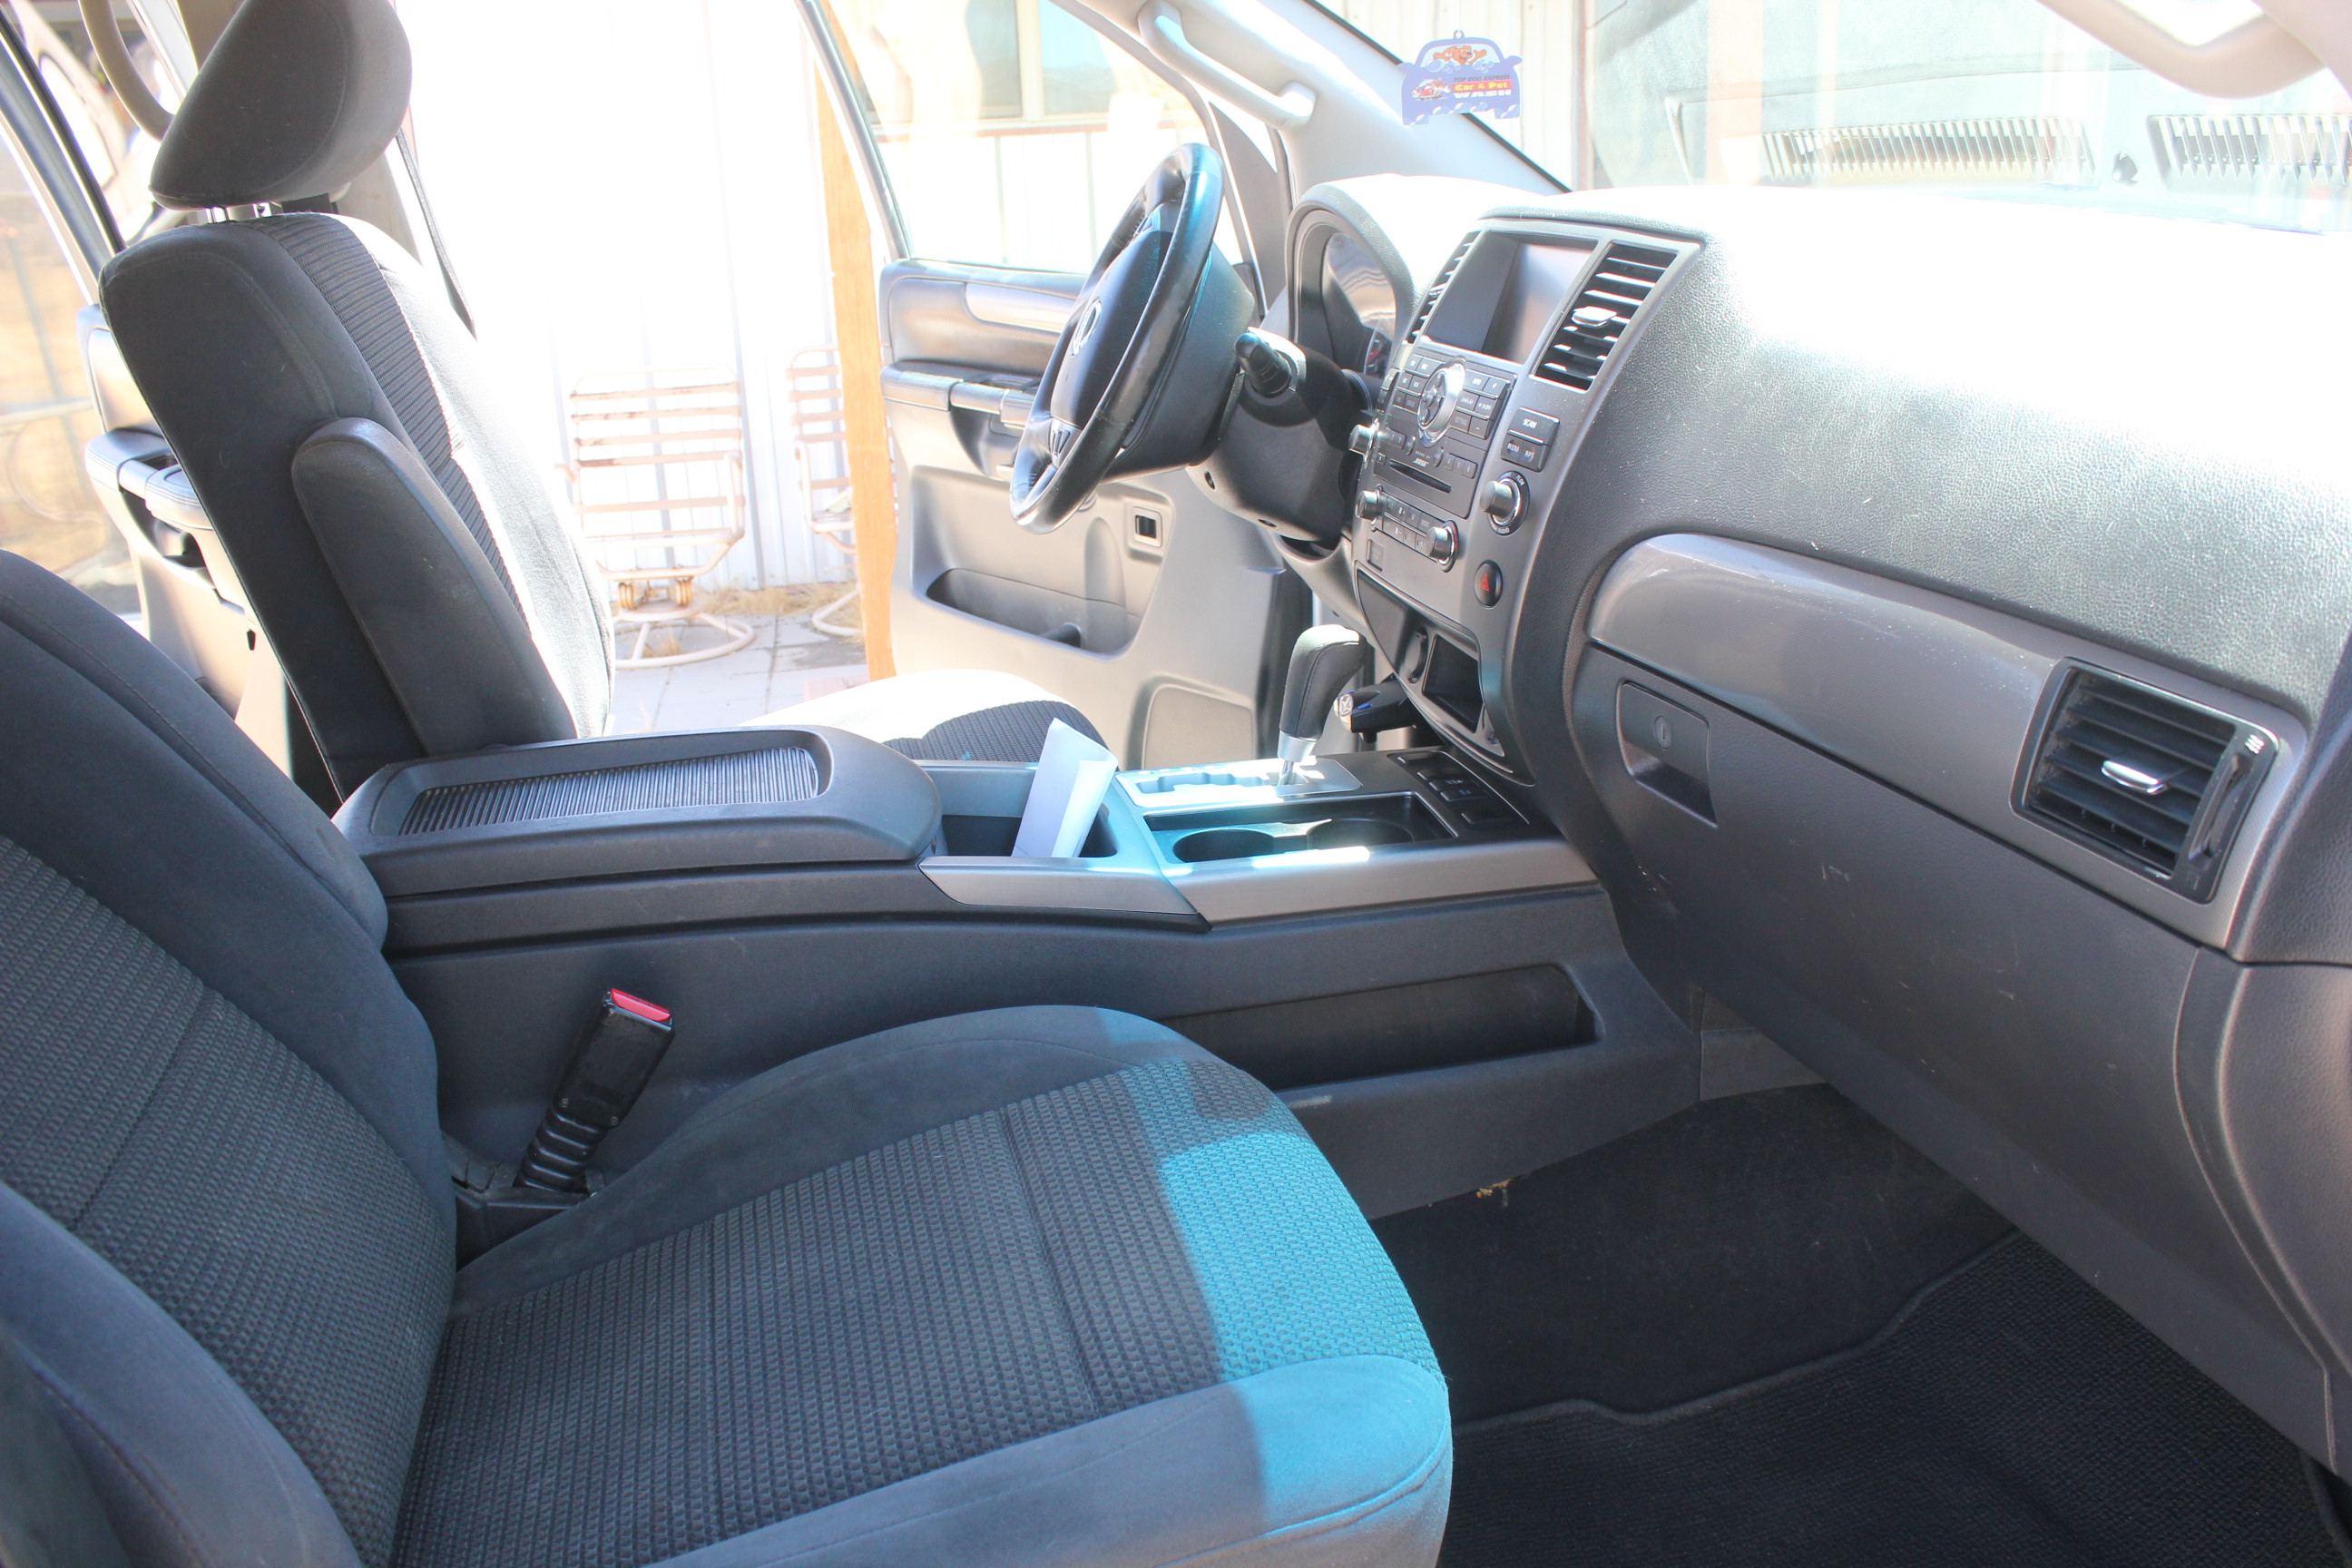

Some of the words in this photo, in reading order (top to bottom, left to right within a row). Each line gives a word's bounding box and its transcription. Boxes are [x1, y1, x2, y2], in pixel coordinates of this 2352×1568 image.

[1453, 90, 1512, 99] WASH
[1522, 418, 1537, 429] SCAN
[1507, 443, 1520, 453] RDM
[1524, 450, 1535, 459] RPT
[1497, 526, 1510, 534] AUDIO
